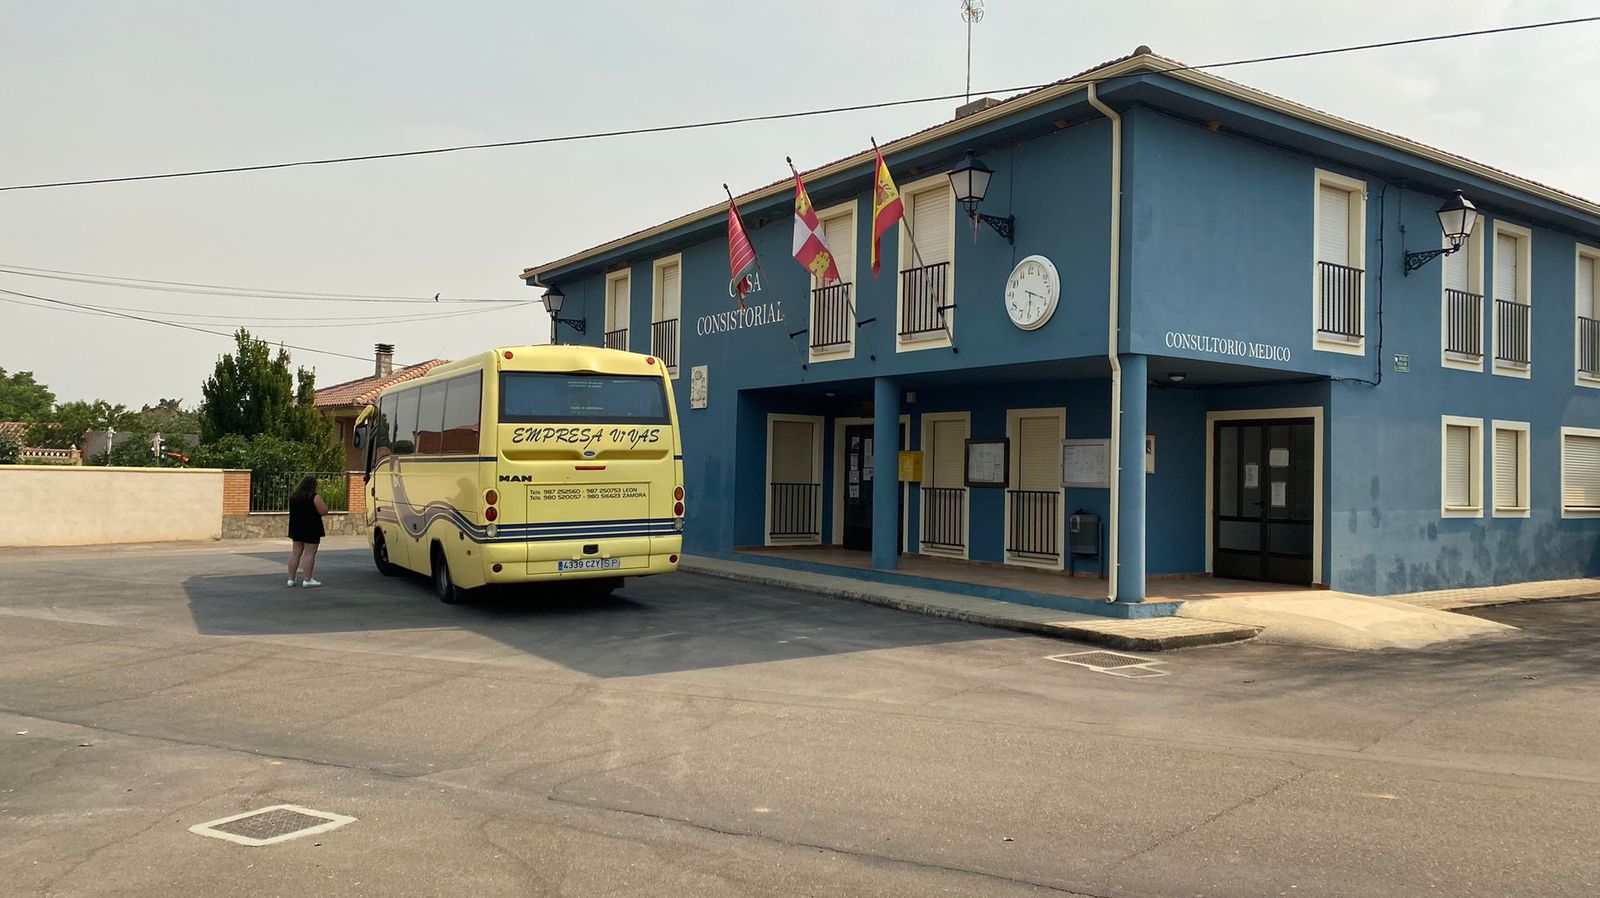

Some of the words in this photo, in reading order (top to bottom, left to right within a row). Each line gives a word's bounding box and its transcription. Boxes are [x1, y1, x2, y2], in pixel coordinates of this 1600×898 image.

[729, 272, 762, 298] CSA
[697, 302, 784, 336] CONSISTORIAL
[1166, 332, 1246, 356] CONSULTORIO
[1249, 342, 1290, 362] MEDICO
[512, 428, 604, 450] EMPRESA
